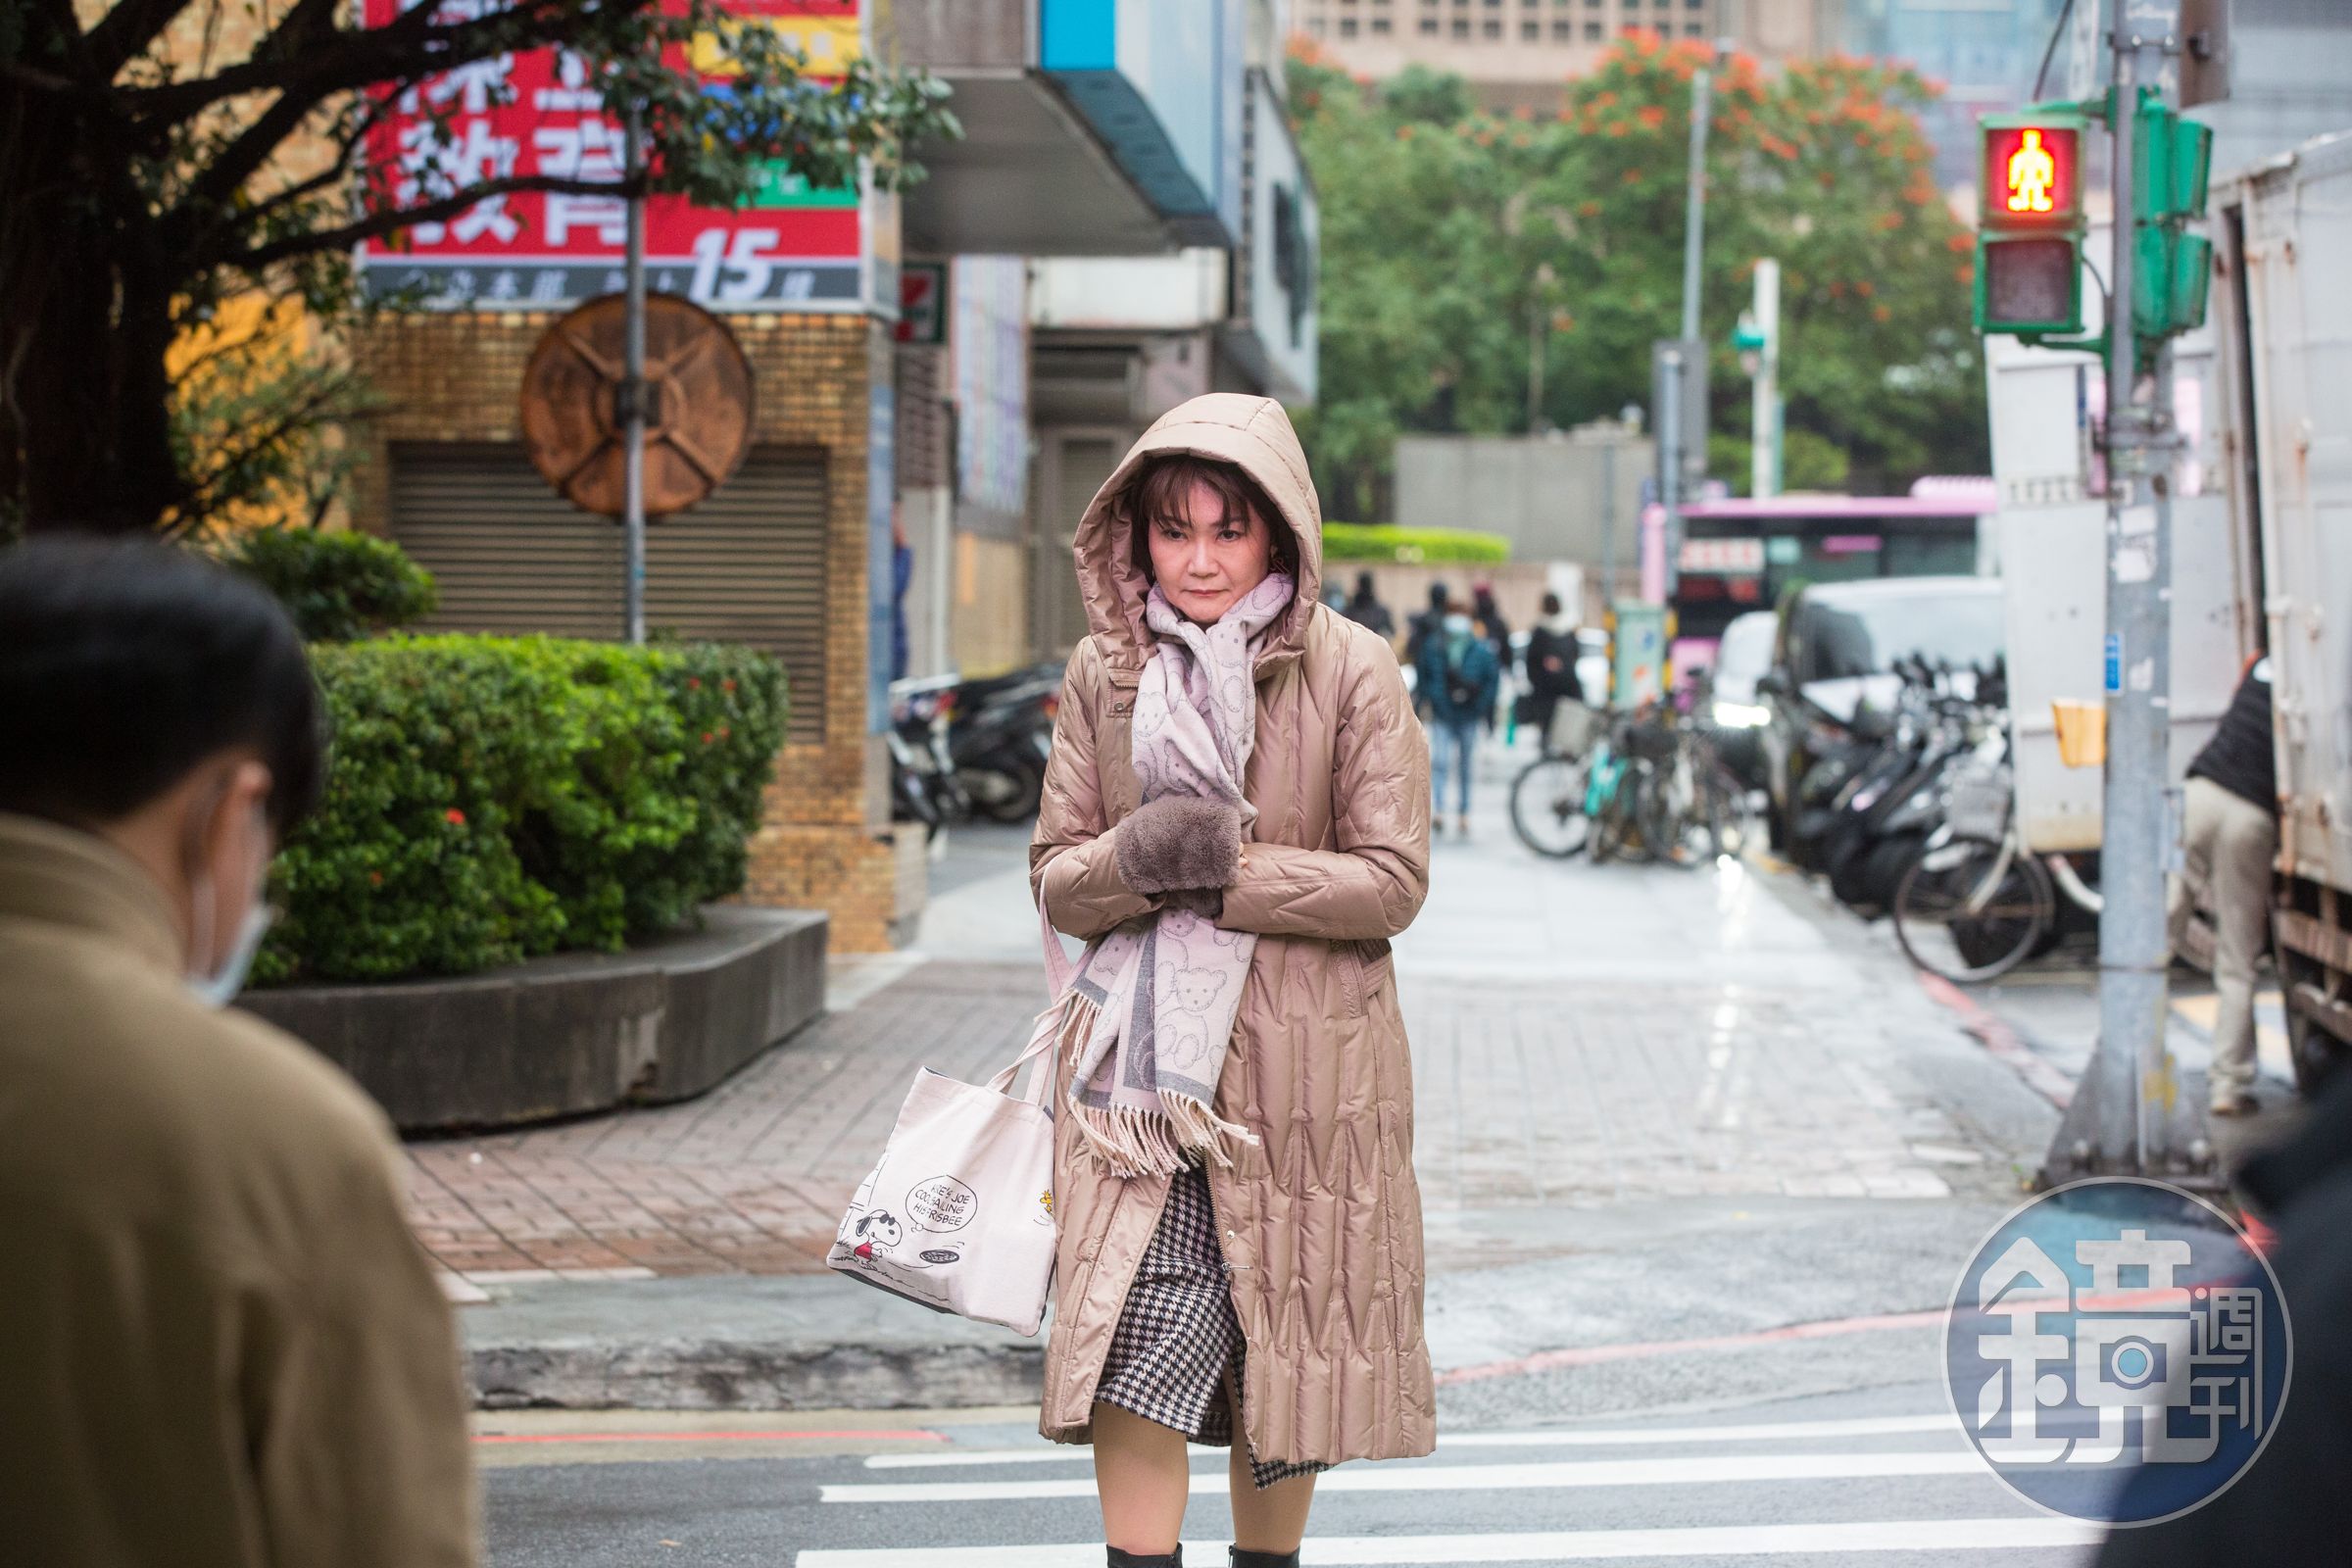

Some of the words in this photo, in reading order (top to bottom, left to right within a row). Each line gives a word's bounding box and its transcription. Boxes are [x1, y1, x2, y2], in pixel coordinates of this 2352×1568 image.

[688, 228, 781, 303] 15
[914, 1189, 931, 1204] COO
[952, 1194, 970, 1204] JOE
